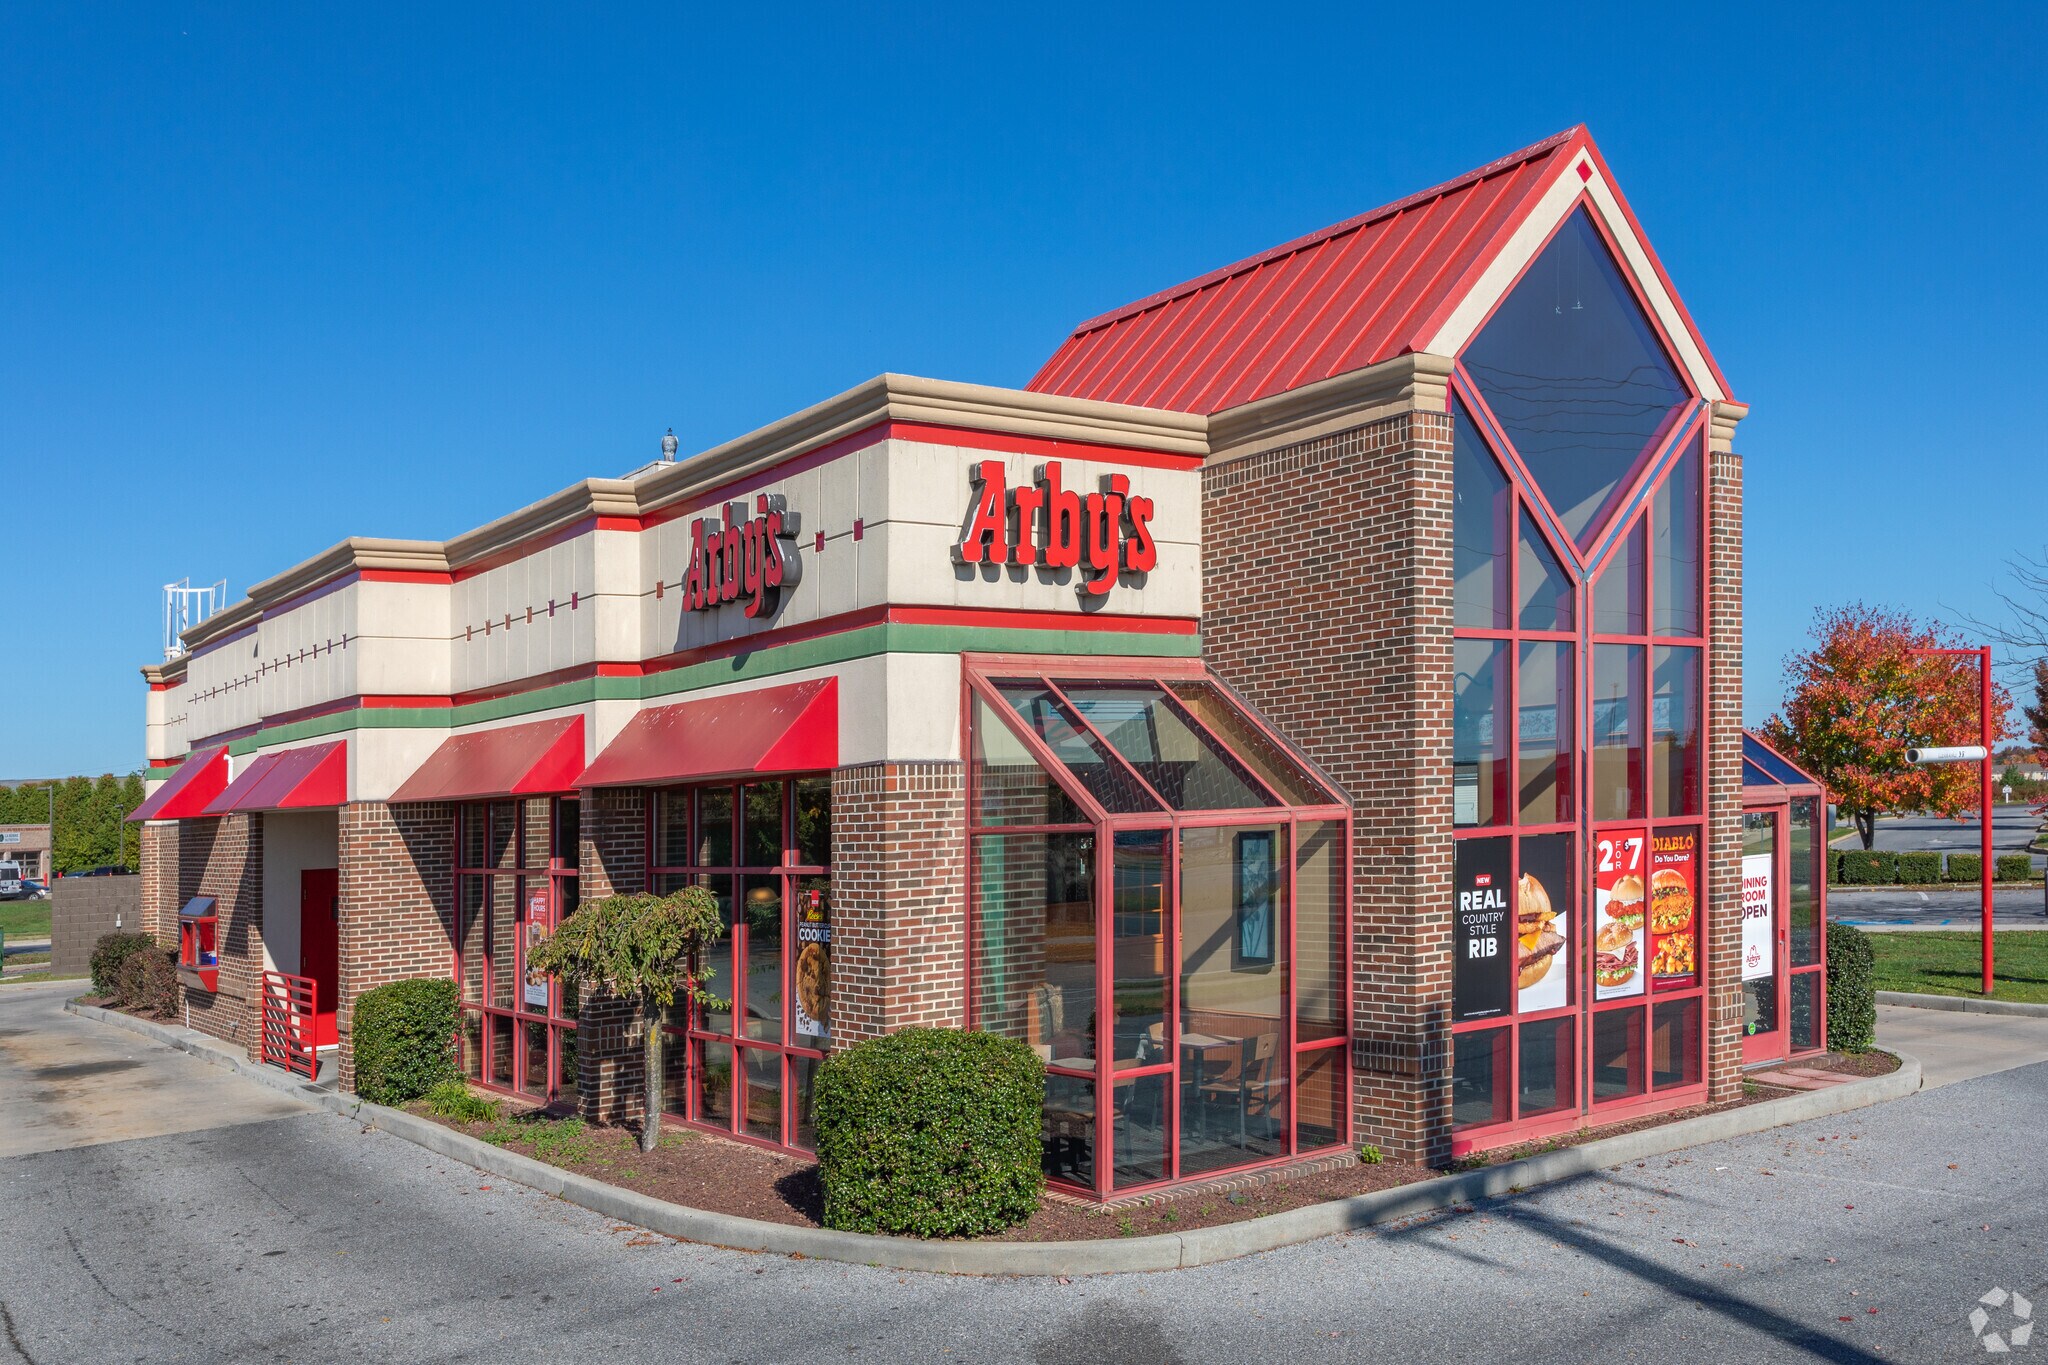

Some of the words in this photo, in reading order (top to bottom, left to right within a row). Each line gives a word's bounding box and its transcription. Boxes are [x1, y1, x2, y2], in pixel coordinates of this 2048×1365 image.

[954, 460, 1157, 595] Arby's
[683, 493, 793, 619] Arby's
[1652, 832, 1694, 851] DIABLO
[1598, 840, 1613, 872] 2
[1655, 855, 1663, 863] Do
[1742, 876, 1767, 889] INING
[1460, 889, 1506, 911] REAL
[1462, 912, 1504, 924] COUNTRY
[800, 928, 831, 942] COOKIE
[1470, 924, 1496, 935] STYLE
[1469, 937, 1498, 959] RIB
